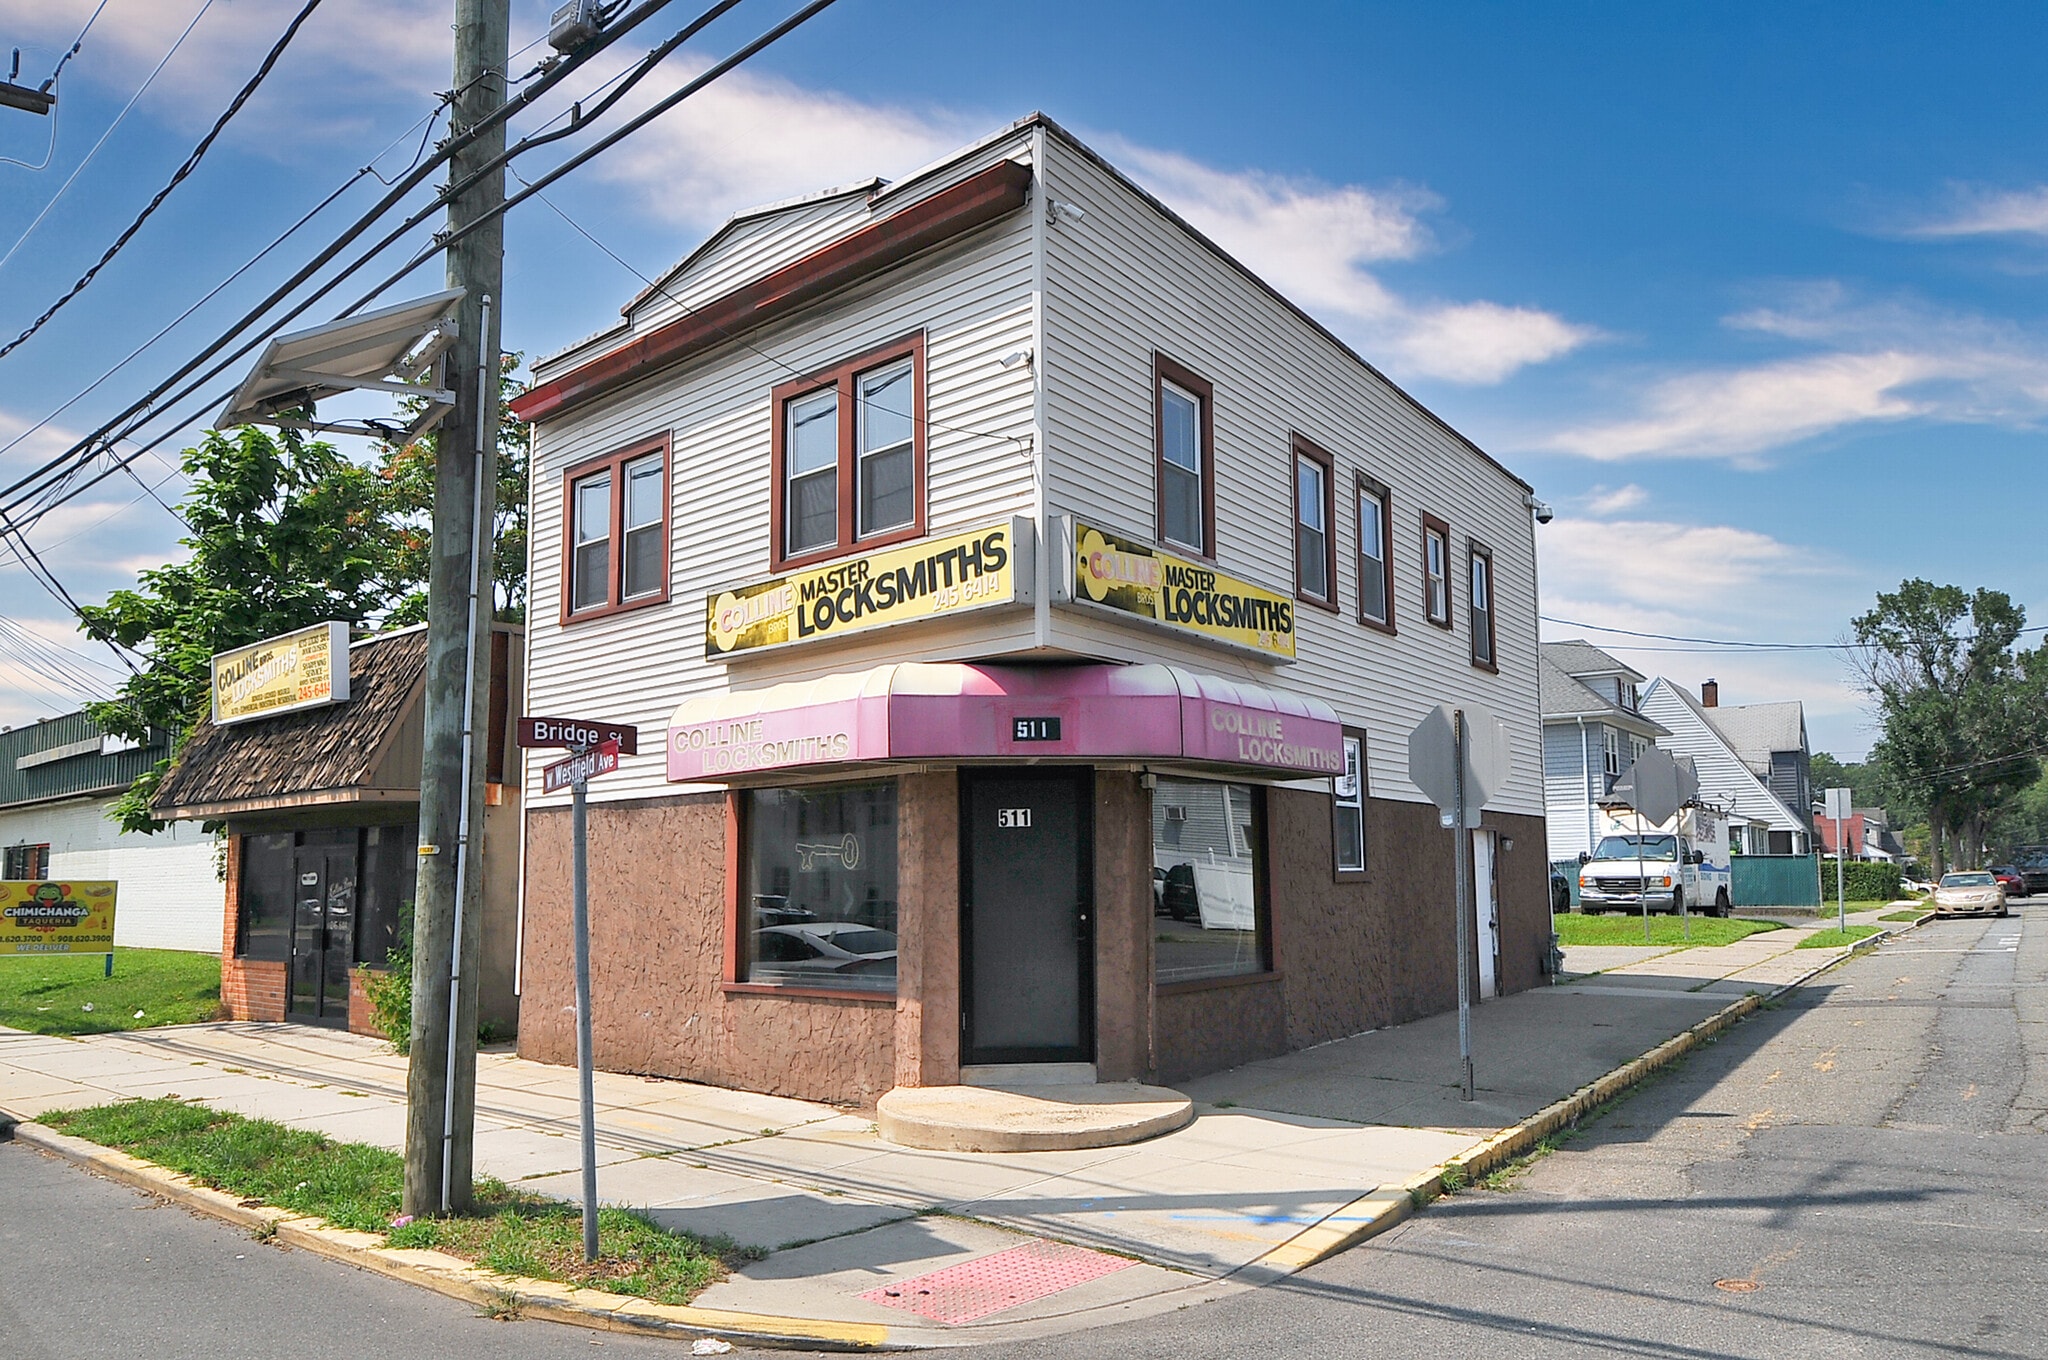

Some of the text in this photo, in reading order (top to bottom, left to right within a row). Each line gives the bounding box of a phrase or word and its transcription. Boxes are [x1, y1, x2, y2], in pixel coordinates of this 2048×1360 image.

[797, 531, 1007, 638] LOCKSMITHS
[800, 559, 870, 602] MASTER
[1089, 551, 1160, 589] COLLINE
[1165, 564, 1216, 592] MASTER
[720, 584, 794, 633] COLLINE
[932, 572, 1000, 612] 245 6414
[1162, 586, 1293, 634] LOCKSMITHS
[218, 649, 260, 692] COLLINE
[232, 646, 298, 704] LOCKSMITHS
[534, 721, 623, 747] Bridge St
[673, 719, 764, 753] COLLINE
[1017, 720, 1047, 738] 511
[1210, 707, 1284, 740] COLLINE
[555, 752, 595, 786] Westfield
[598, 753, 614, 771] Ave
[702, 732, 849, 773] LOCKSMITHS
[1237, 737, 1341, 771] LOCKSMITHS
[999, 809, 1029, 827] 511
[4, 907, 89, 917] CHIMICHANGA
[33, 943, 70, 951] DELIVER
